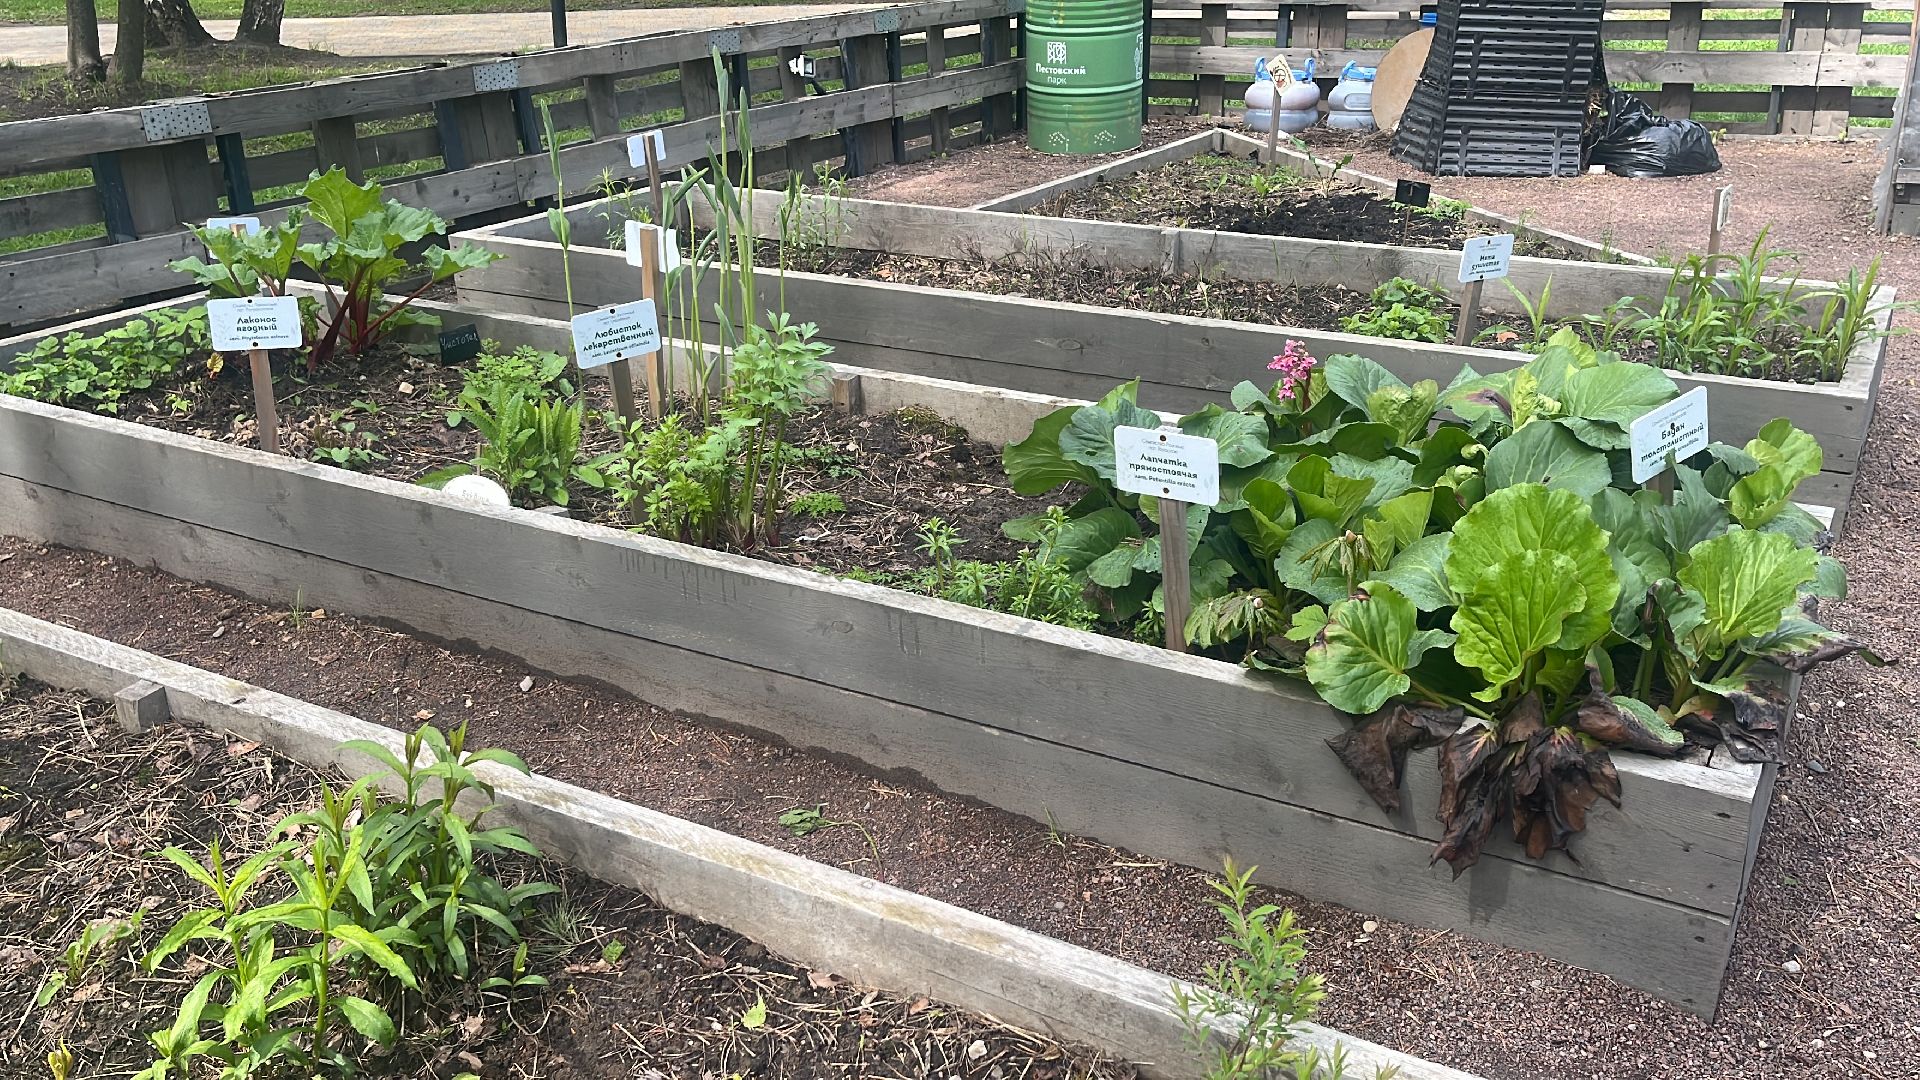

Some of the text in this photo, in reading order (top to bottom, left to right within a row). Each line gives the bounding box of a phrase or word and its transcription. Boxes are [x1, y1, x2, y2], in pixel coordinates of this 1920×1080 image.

[1035, 62, 1087, 75] Пестовский
[1047, 75, 1067, 86] парк
[236, 316, 277, 325] Лаконос
[236, 324, 278, 333] ягодный
[594, 321, 642, 340] Любисток
[583, 328, 654, 352] лекарственный
[1661, 422, 1685, 440] Бадан
[1640, 422, 1704, 462] толстолистный
[1140, 453, 1188, 468] Лапчатка
[1129, 462, 1198, 479] прямостоячая
